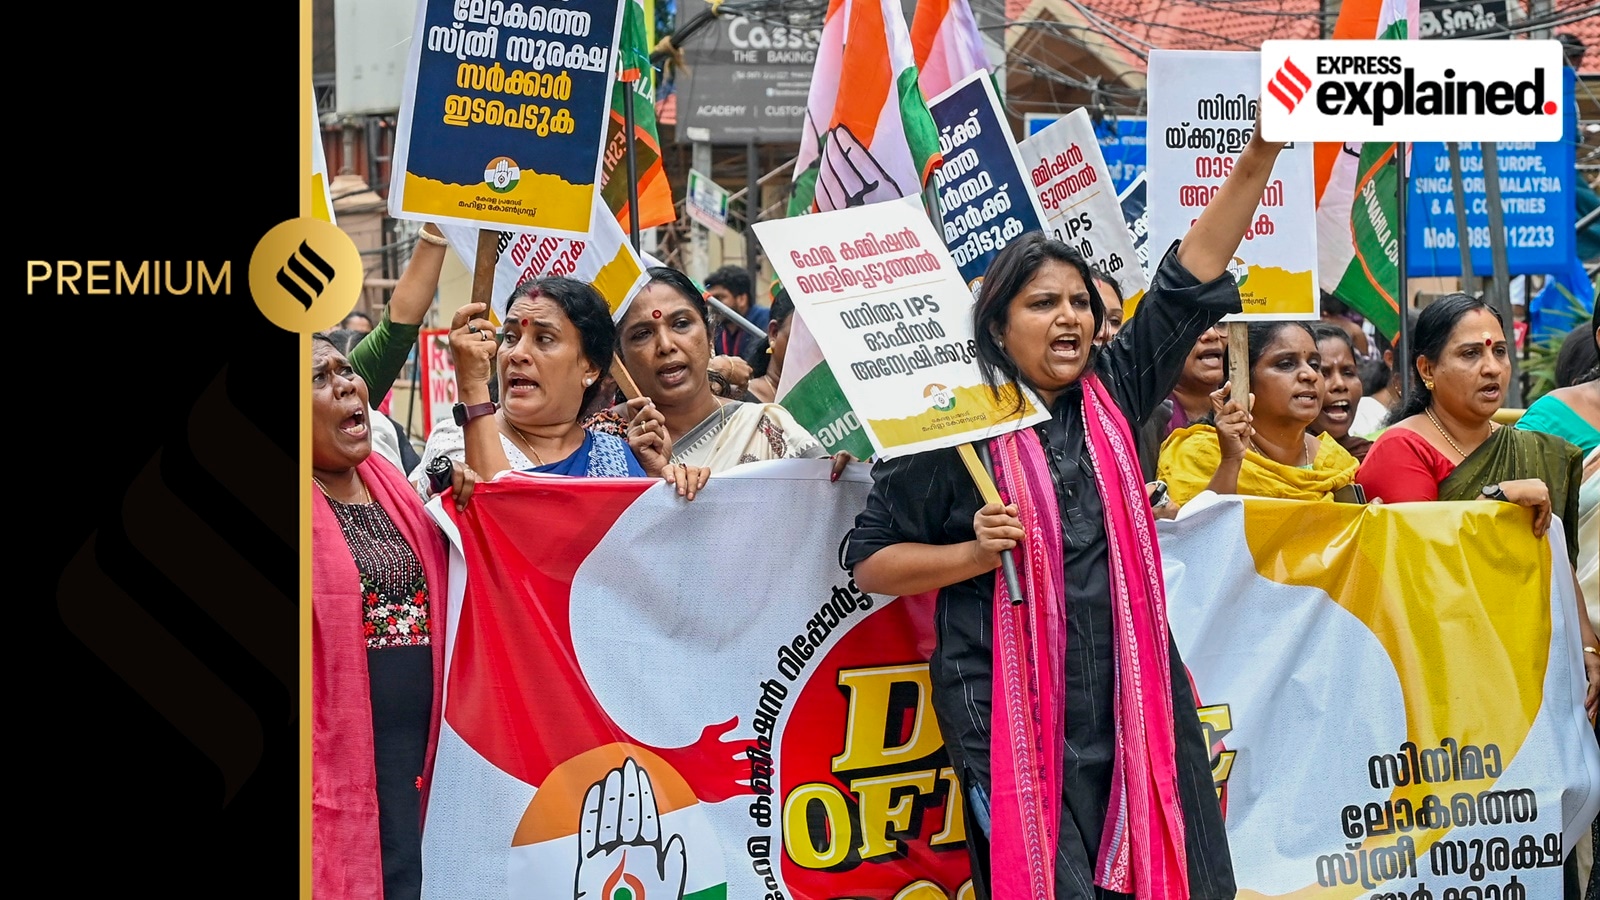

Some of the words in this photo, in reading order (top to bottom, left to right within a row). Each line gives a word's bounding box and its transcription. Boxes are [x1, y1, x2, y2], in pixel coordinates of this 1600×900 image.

[427, 22, 499, 60] സ്ത്രീ
[505, 35, 609, 73] സുരക്ഷ
[733, 51, 757, 63] THE
[767, 51, 814, 63] BAKING
[456, 62, 572, 101] സർക്കാർ
[443, 95, 575, 138] ഇടപെടുക
[696, 106, 747, 117] ACADEMY
[1063, 211, 1093, 242] IPS
[790, 244, 837, 269] ഹേമ
[840, 302, 903, 330] വനിതാ
[903, 294, 940, 318] IPS
[1368, 737, 1503, 789] സിനിമാ
[1341, 788, 1538, 840] ലോകത്തെ
[1315, 835, 1417, 890] സ്ത്രീ
